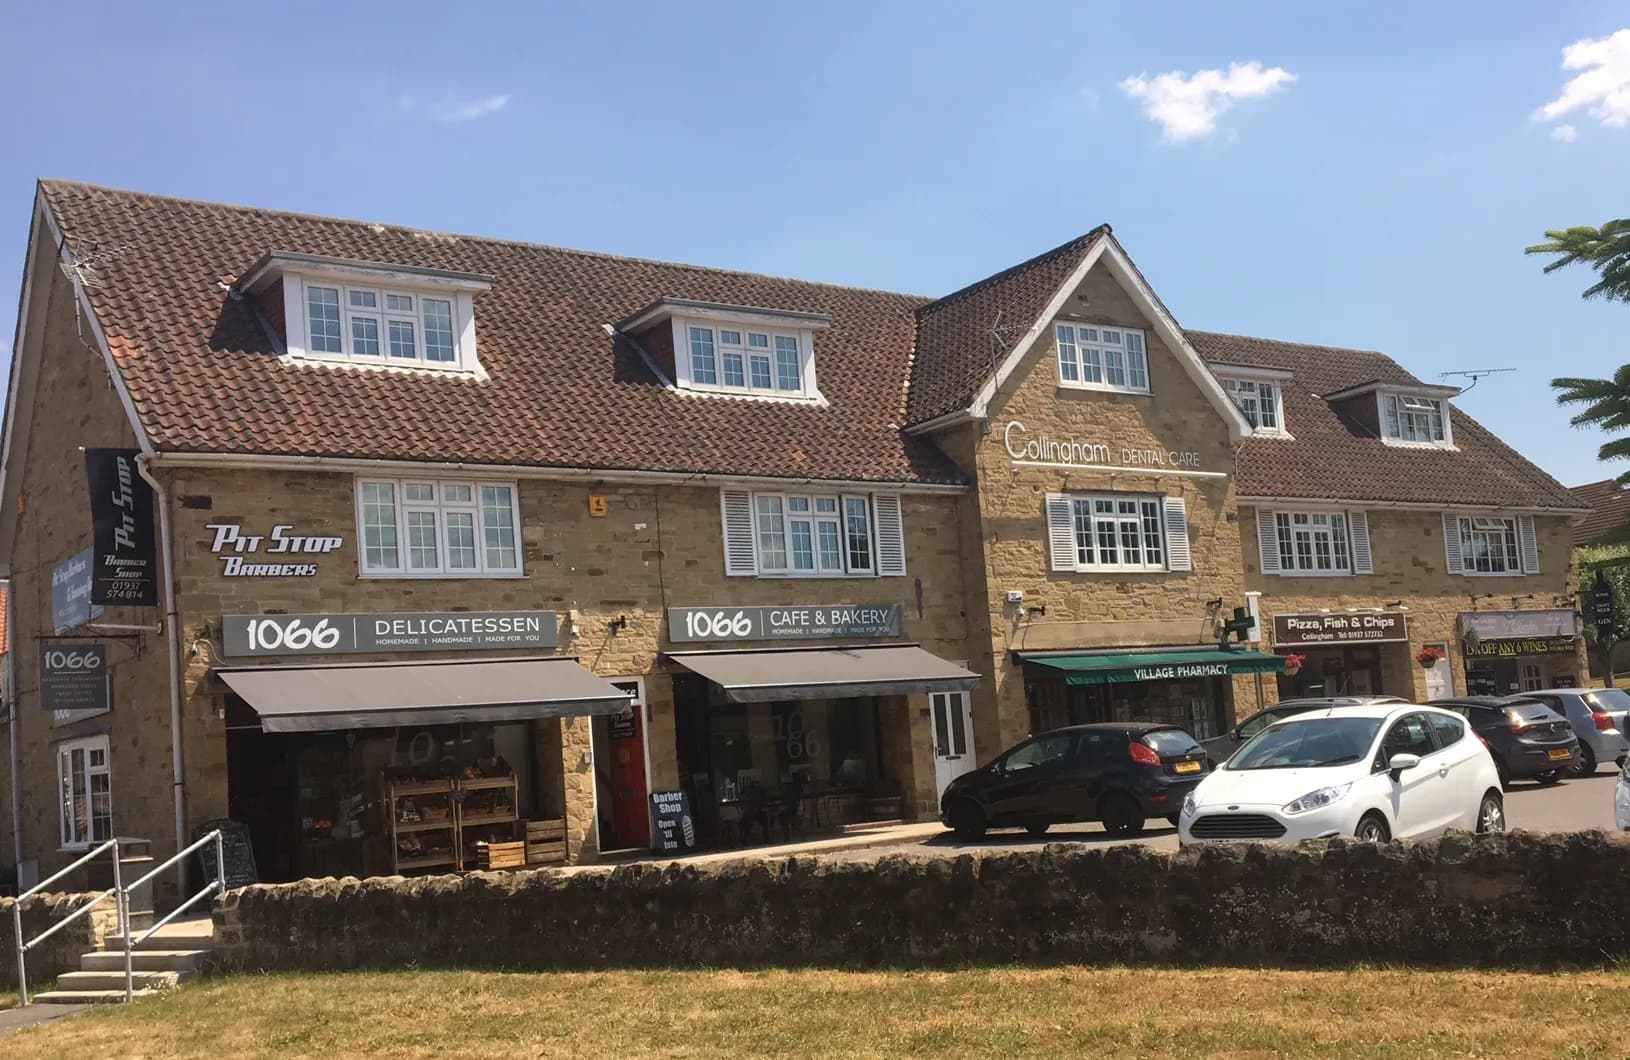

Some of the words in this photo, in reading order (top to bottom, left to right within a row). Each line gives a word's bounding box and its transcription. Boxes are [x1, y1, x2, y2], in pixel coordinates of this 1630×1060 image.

[1004, 420, 1111, 465] Collingham
[1122, 449, 1165, 466] DENTAL
[1168, 451, 1201, 467] CARE
[112, 456, 133, 511] STOP
[114, 512, 135, 551] PIT
[206, 524, 264, 553] PIT
[267, 525, 343, 553] STOP
[220, 556, 318, 576] BARBERS
[112, 581, 140, 591] 01937
[686, 611, 752, 638] 1066
[770, 610, 810, 626] CAFE
[815, 610, 827, 625] &
[831, 609, 889, 625] BAKERY
[1287, 618, 1323, 631] Pizza,
[1324, 617, 1348, 629] Fish
[1351, 617, 1361, 628] &
[1363, 616, 1395, 629] Chips
[246, 618, 340, 651] 1066
[375, 617, 540, 636] DELICATESSEN
[376, 638, 419, 646] HOMEMADE
[432, 636, 473, 645] HANDMADE
[485, 635, 505, 643] MADE
[1301, 632, 1334, 641] Collingham
[1481, 642, 1497, 655] OFF
[1499, 642, 1516, 655] ANY
[1522, 641, 1548, 652] WINES
[45, 651, 100, 669] 1066
[1134, 666, 1174, 680] VILLAGE
[1177, 664, 1228, 677] PHARMACY
[652, 791, 683, 804] Barber
[659, 803, 682, 814] Shop
[658, 819, 676, 829] Open
